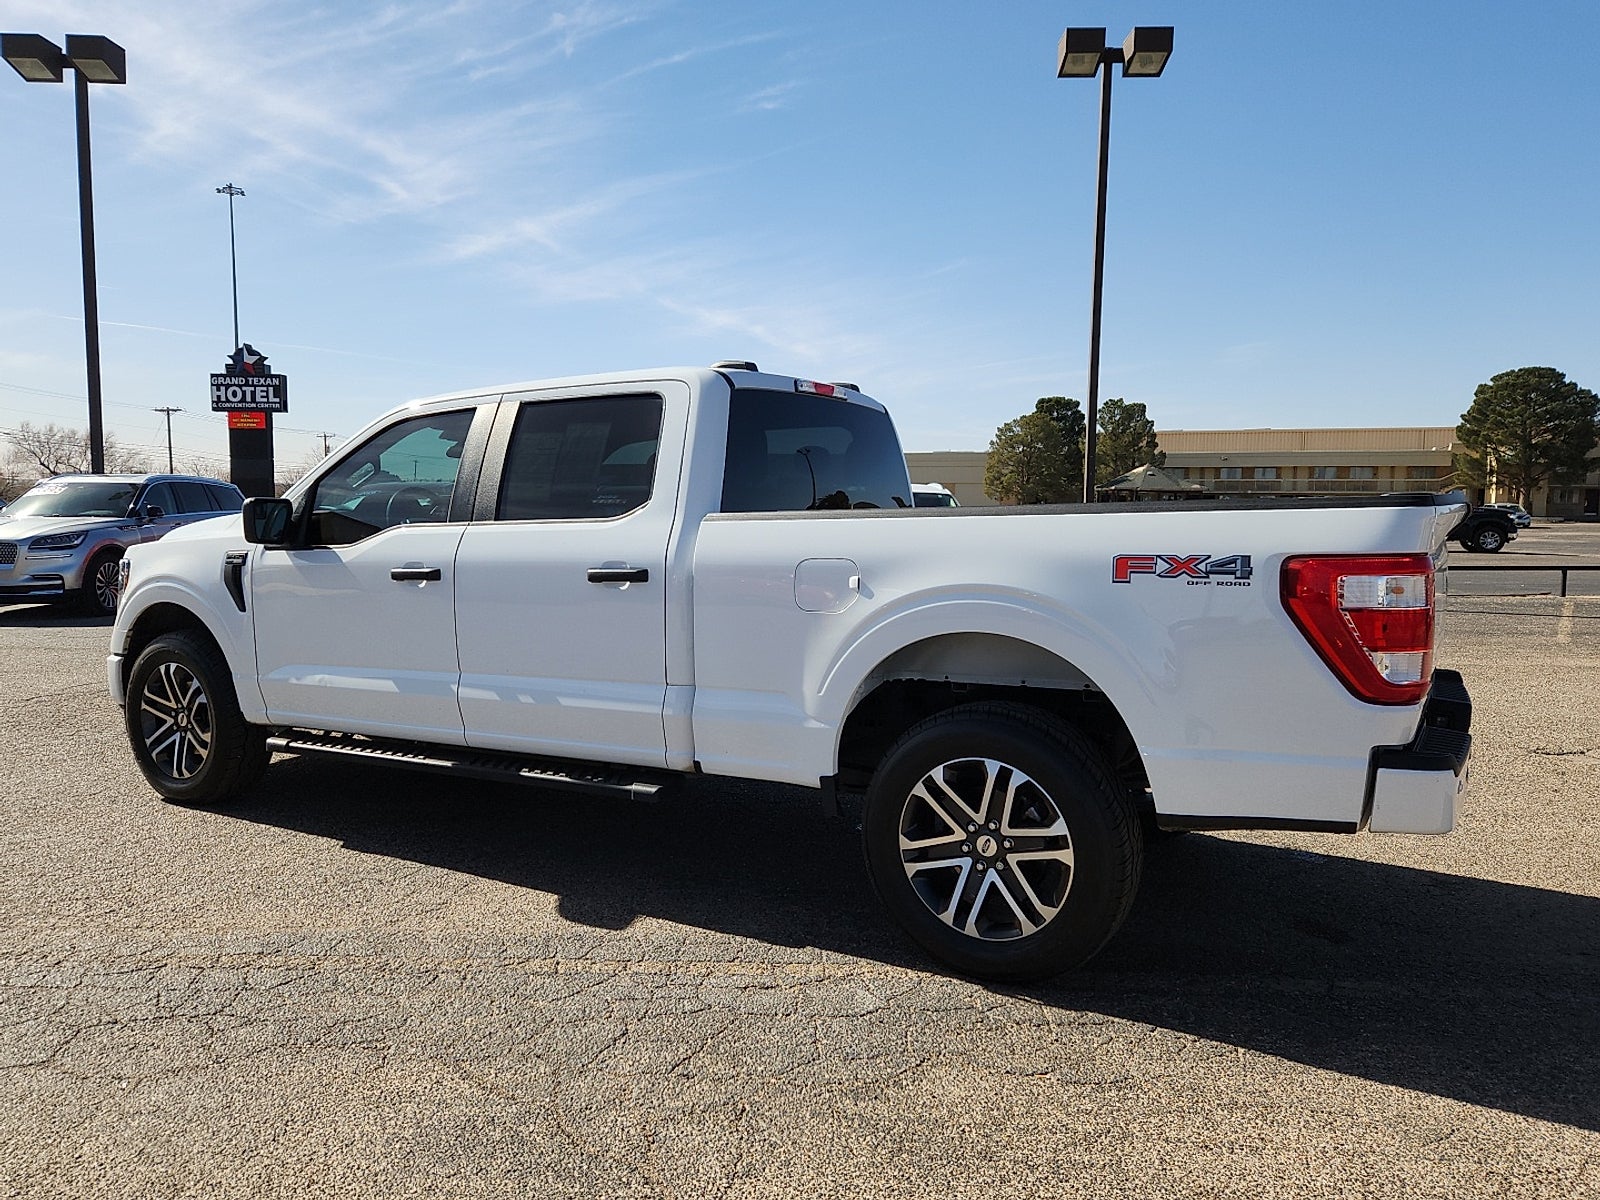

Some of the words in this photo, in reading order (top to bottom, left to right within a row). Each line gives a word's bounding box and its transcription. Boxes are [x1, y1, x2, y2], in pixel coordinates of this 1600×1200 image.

[211, 377, 245, 385] GRAND
[247, 377, 279, 385] TEXAN
[212, 386, 280, 402] HOTEL
[1112, 554, 1253, 583] FX4
